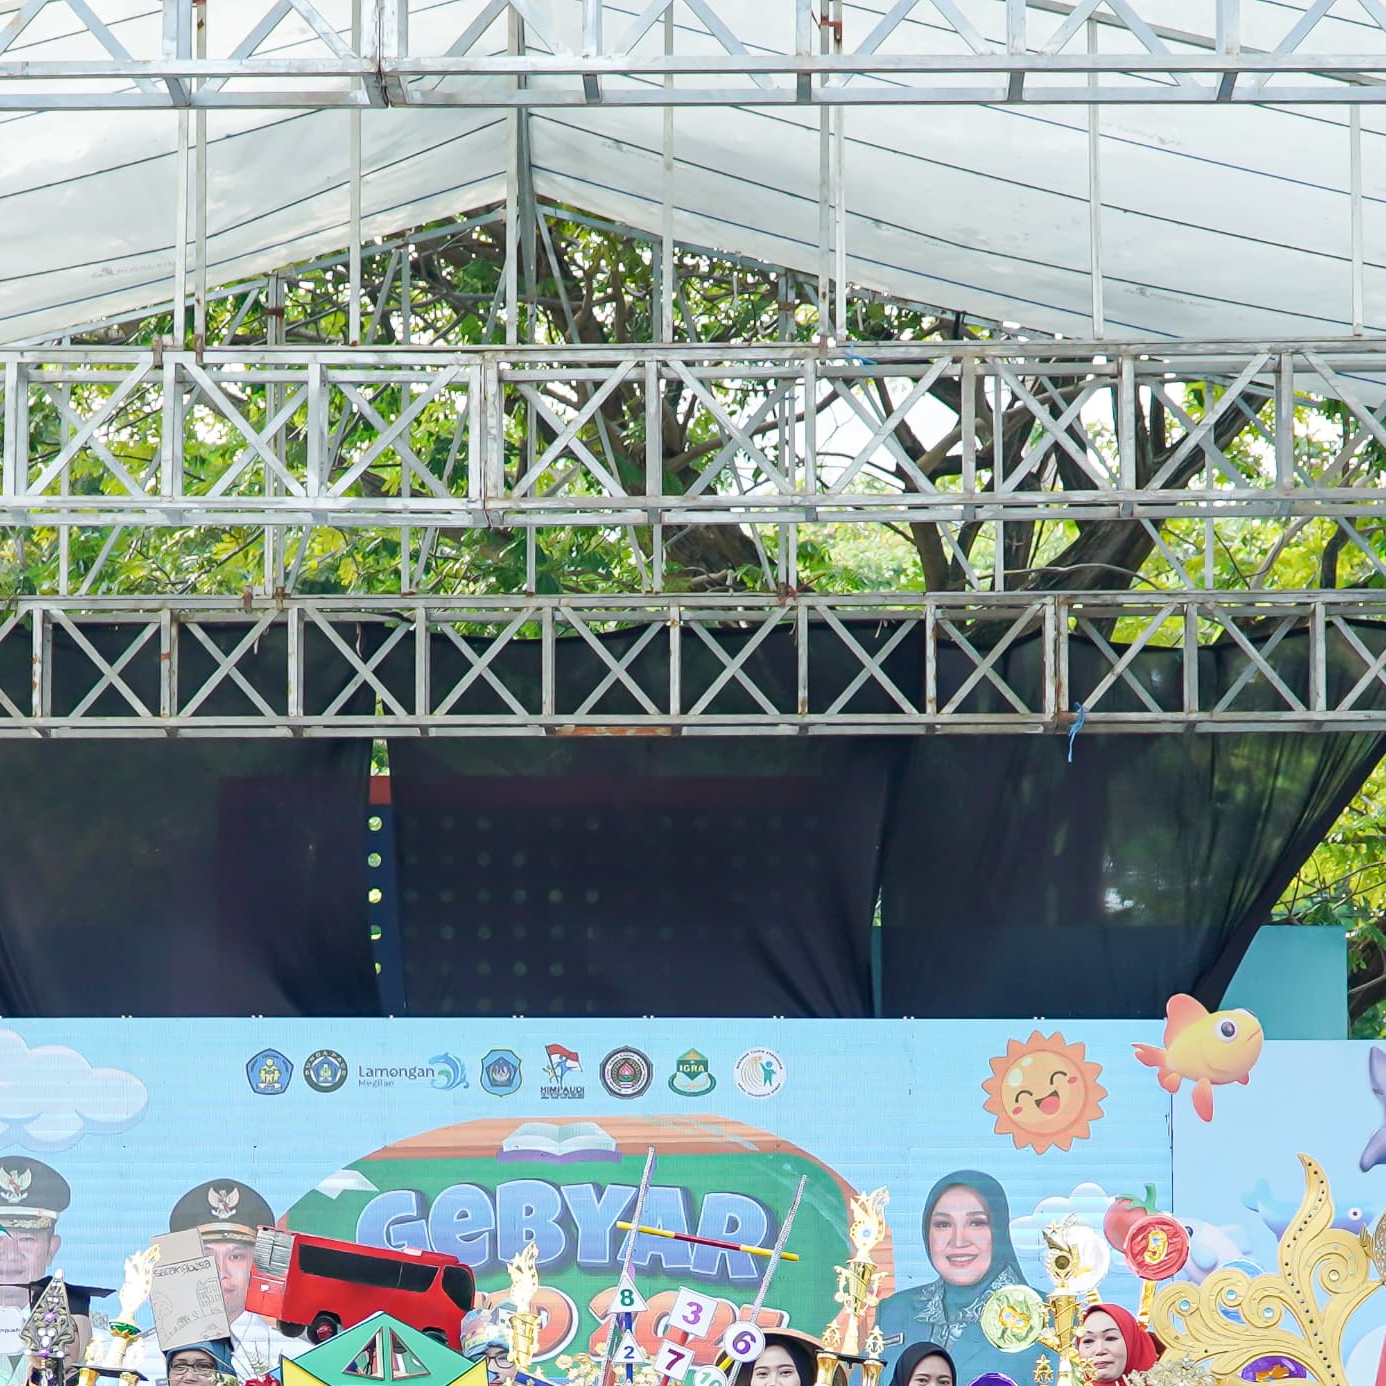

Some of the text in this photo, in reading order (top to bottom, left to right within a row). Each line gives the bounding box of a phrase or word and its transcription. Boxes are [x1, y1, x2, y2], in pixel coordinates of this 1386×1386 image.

[359, 1065, 435, 1080] Lamongan
[679, 1063, 706, 1073] IGRA
[540, 1086, 585, 1094] HIMPAUDI
[620, 1289, 635, 1307] 8
[682, 1301, 703, 1325] 3
[732, 1330, 756, 1355] 6
[624, 1345, 635, 1360] 2
[666, 1348, 686, 1371] 7
